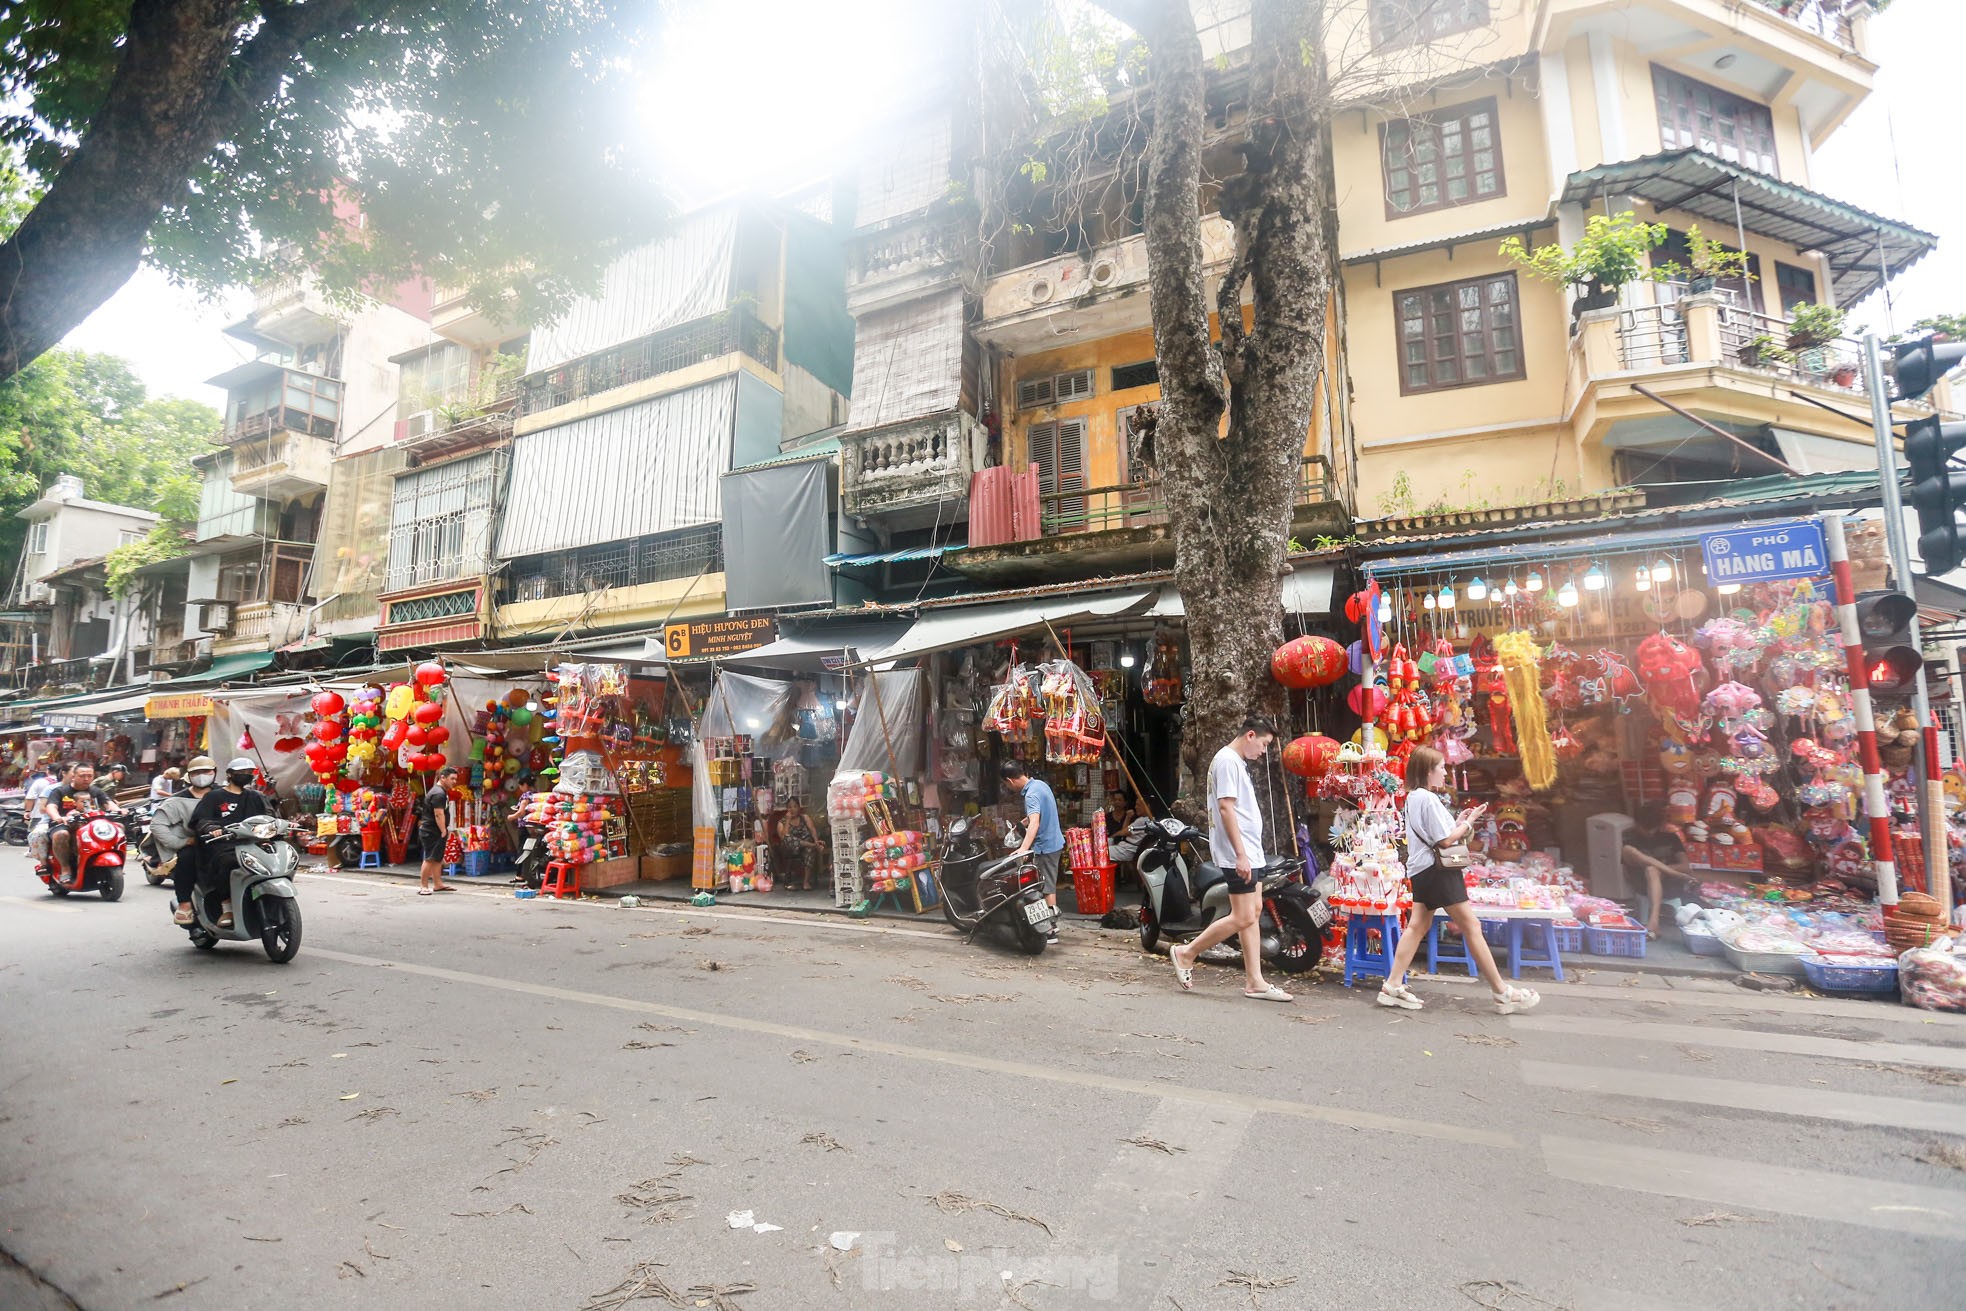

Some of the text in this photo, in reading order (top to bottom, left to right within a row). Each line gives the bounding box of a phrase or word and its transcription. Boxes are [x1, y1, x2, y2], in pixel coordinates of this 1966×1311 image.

[1752, 530, 1790, 546] PHỐ
[1716, 544, 1819, 576] HÀNG MÃ
[691, 624, 712, 635] HIỆU
[714, 620, 749, 632] HƯƠNG
[751, 618, 769, 629] ĐEN
[708, 632, 753, 644] MINH NGUYỆT
